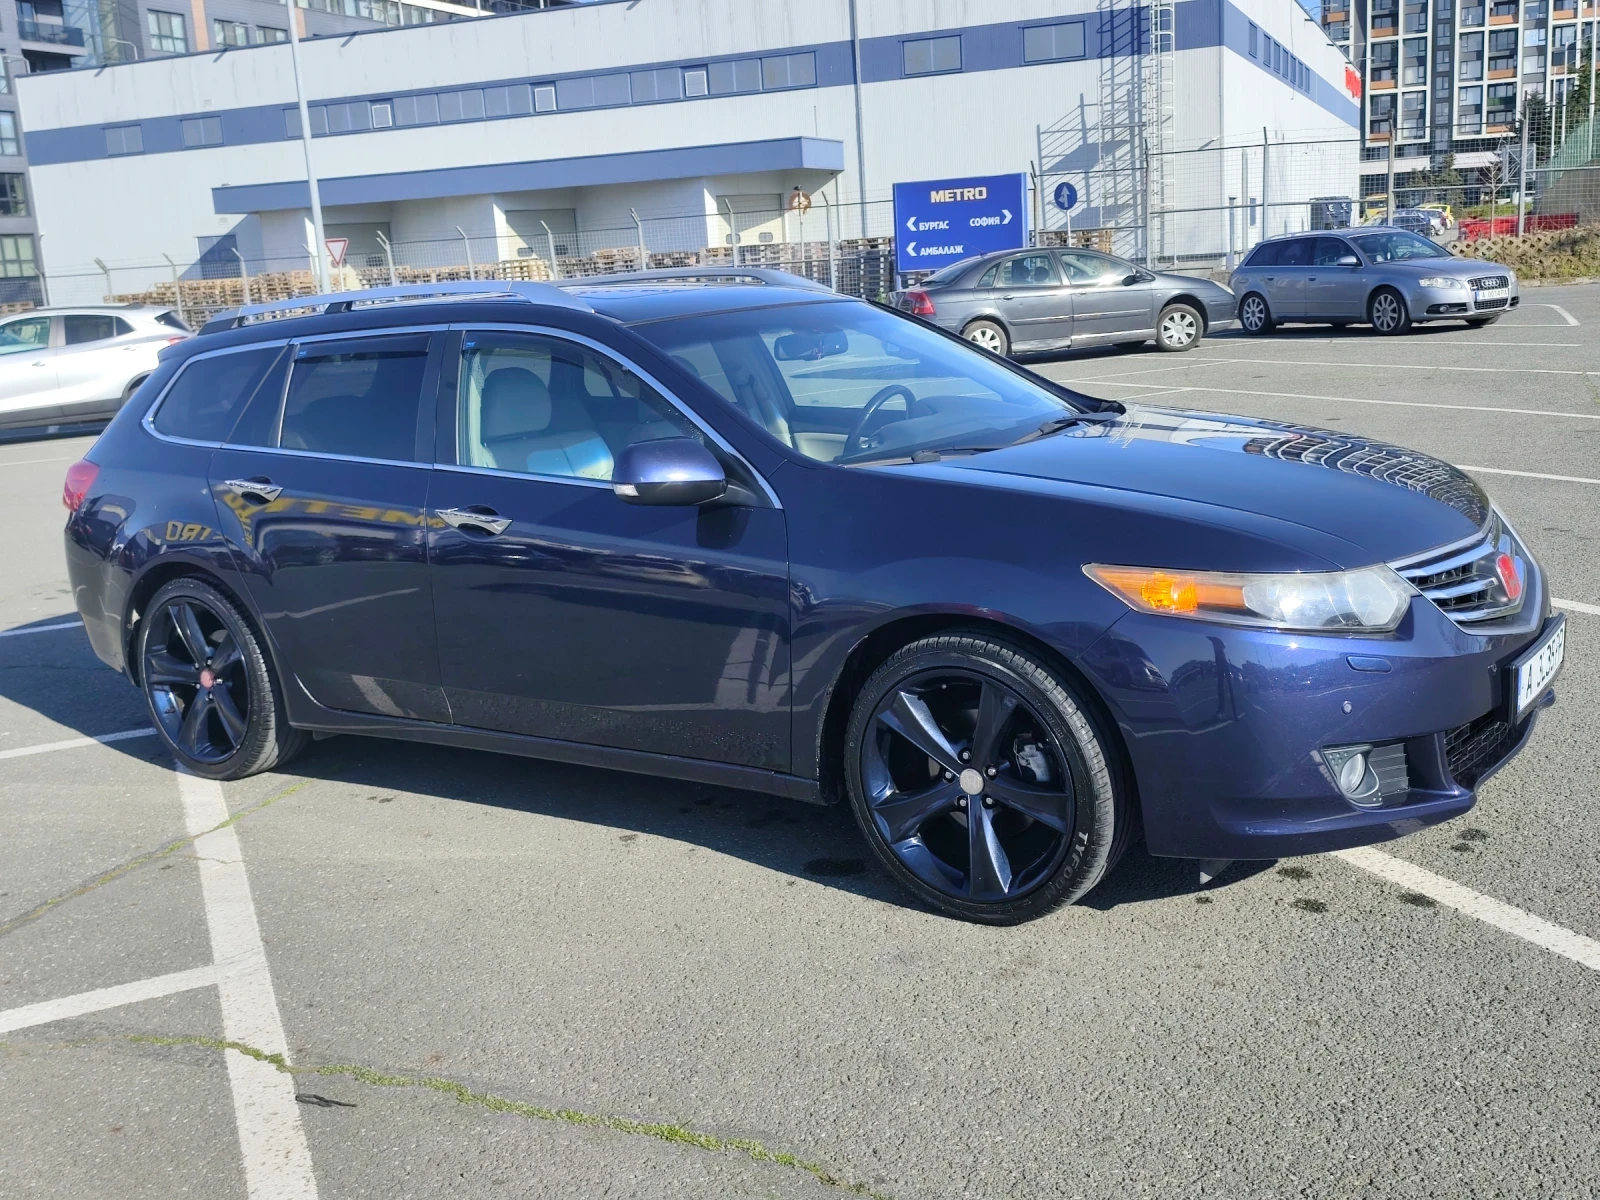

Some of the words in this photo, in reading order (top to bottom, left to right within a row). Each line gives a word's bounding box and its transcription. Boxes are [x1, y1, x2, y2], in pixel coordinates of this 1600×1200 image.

[930, 186, 987, 203] METRO
[918, 220, 950, 231] БУРГАС
[969, 216, 1001, 227] СОФИЯ
[920, 245, 964, 256] АМБАЛАЖ
[1044, 831, 1089, 899] TYFOON
